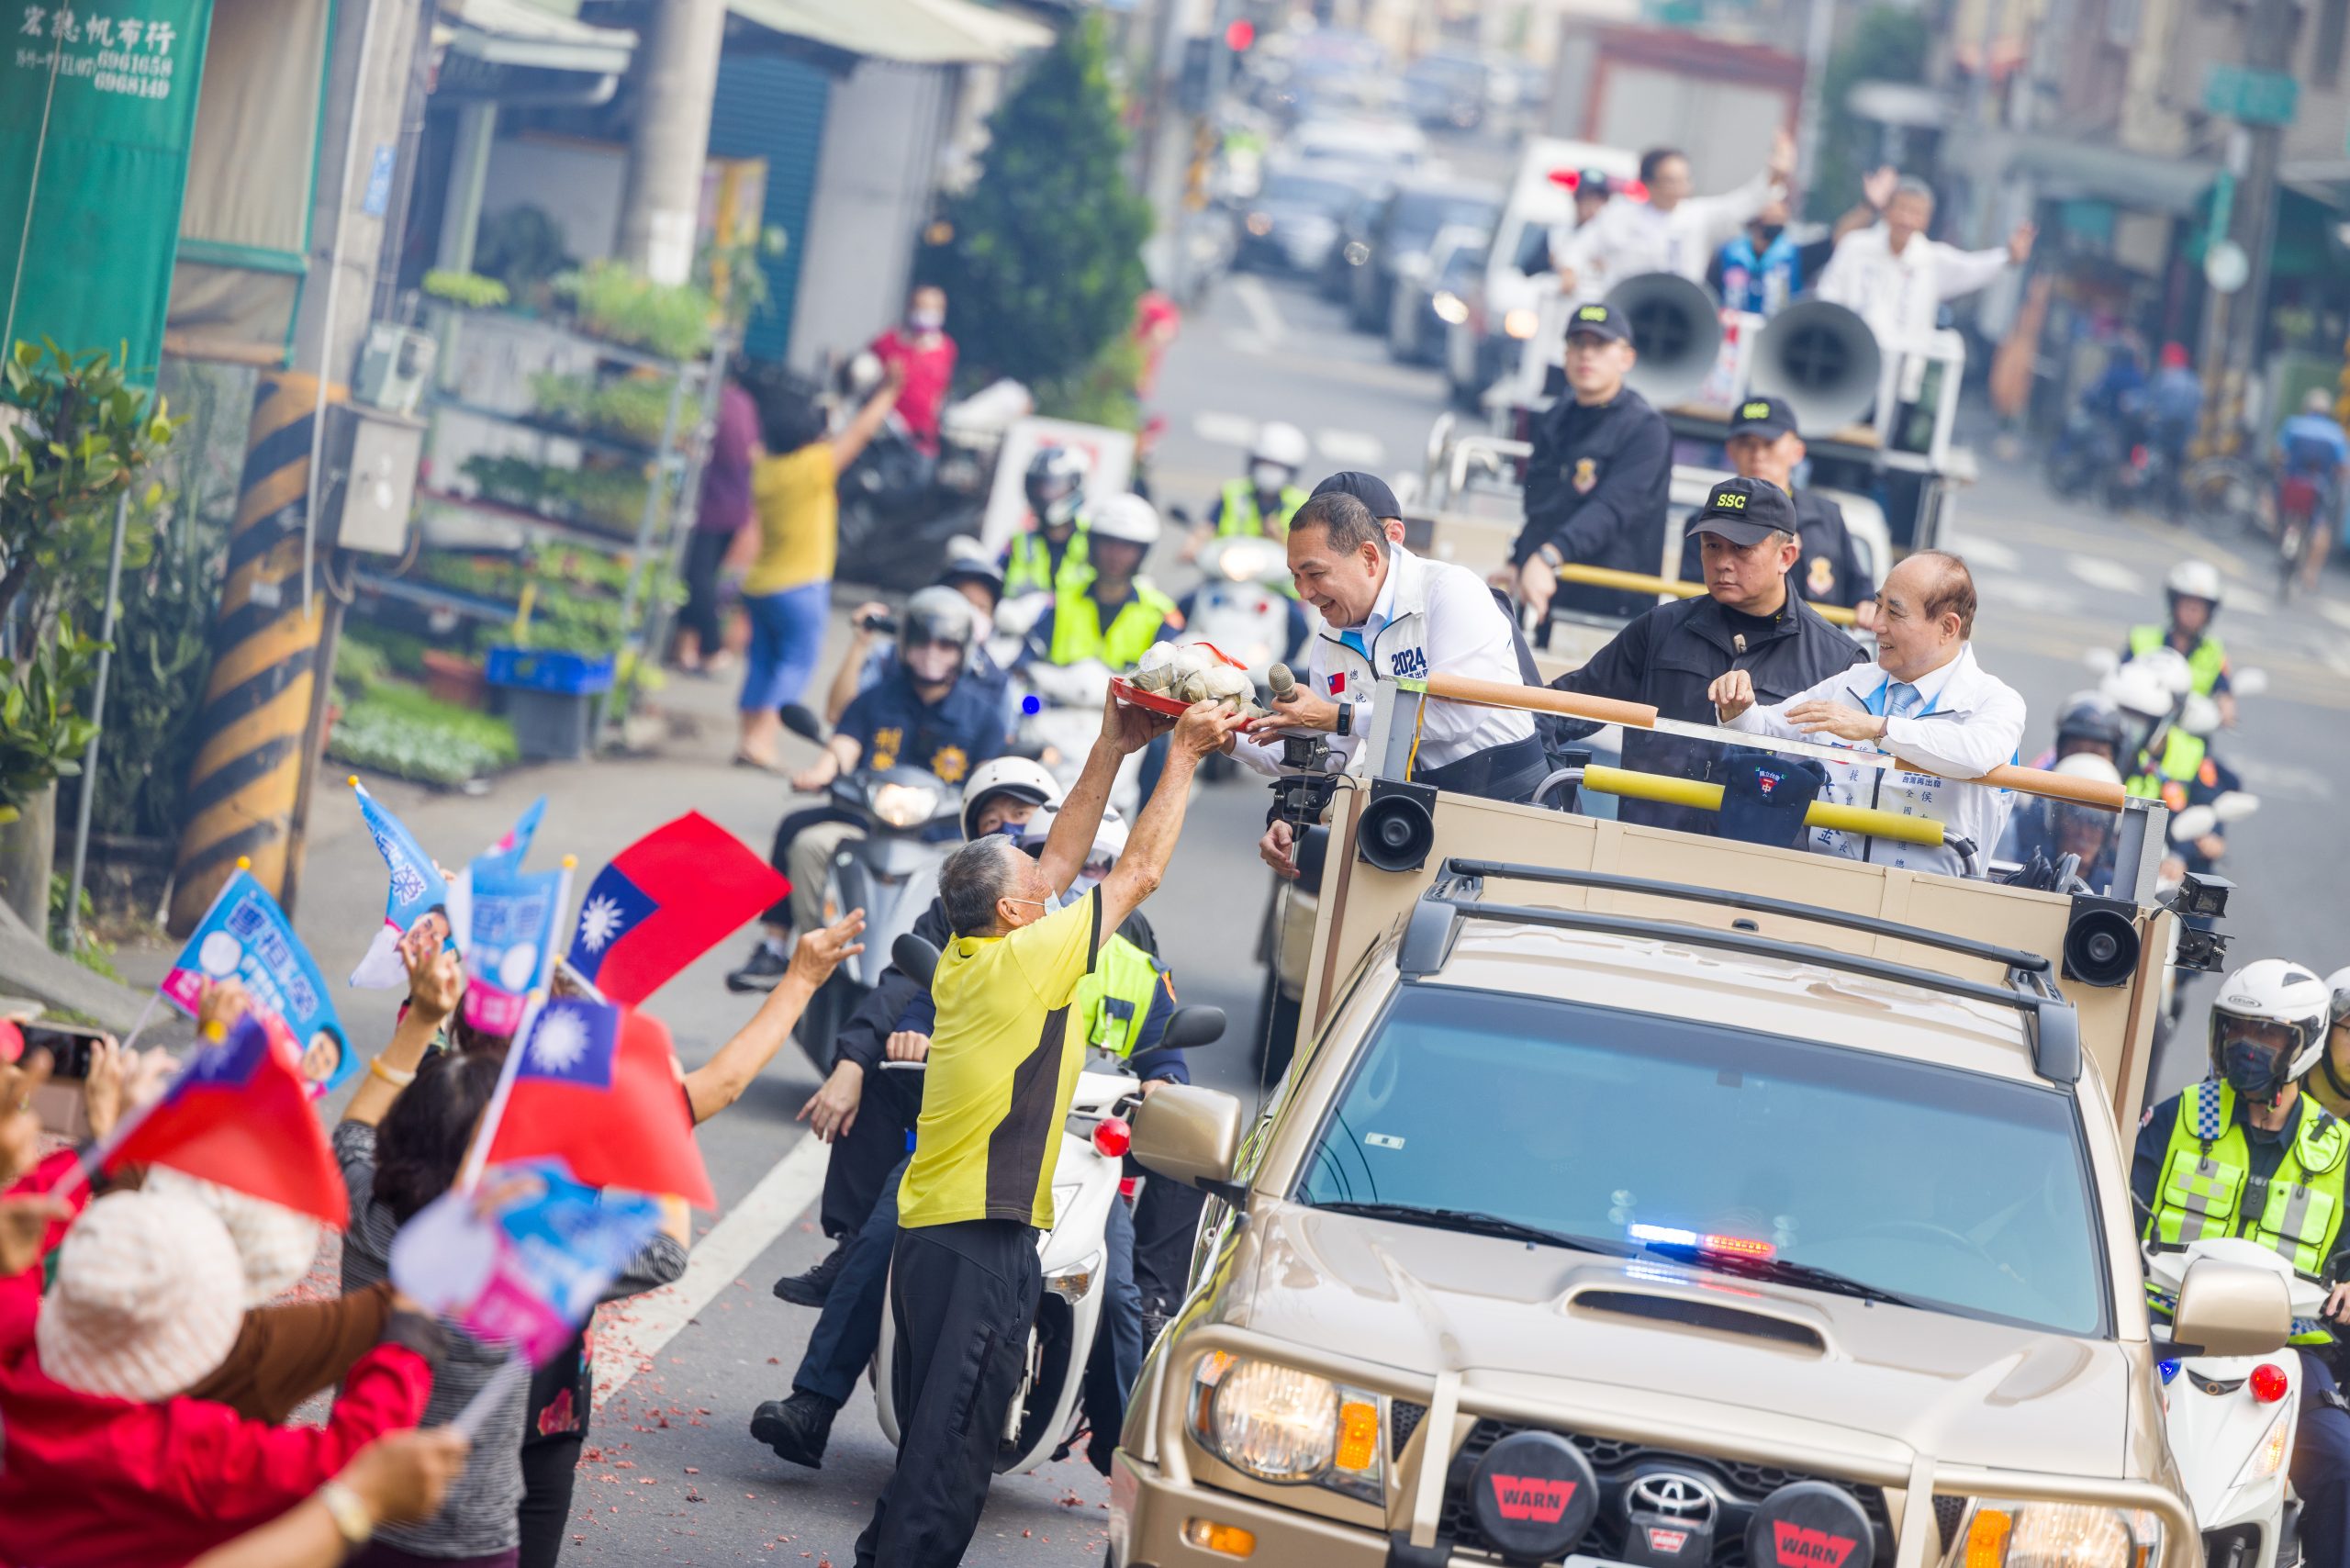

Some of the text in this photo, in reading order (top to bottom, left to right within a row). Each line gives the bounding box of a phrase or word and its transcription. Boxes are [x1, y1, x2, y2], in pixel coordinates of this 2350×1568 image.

[1391, 646, 1427, 676] 2024
[1503, 1490, 1561, 1509] WARN
[1782, 1537, 1839, 1564] WARN
